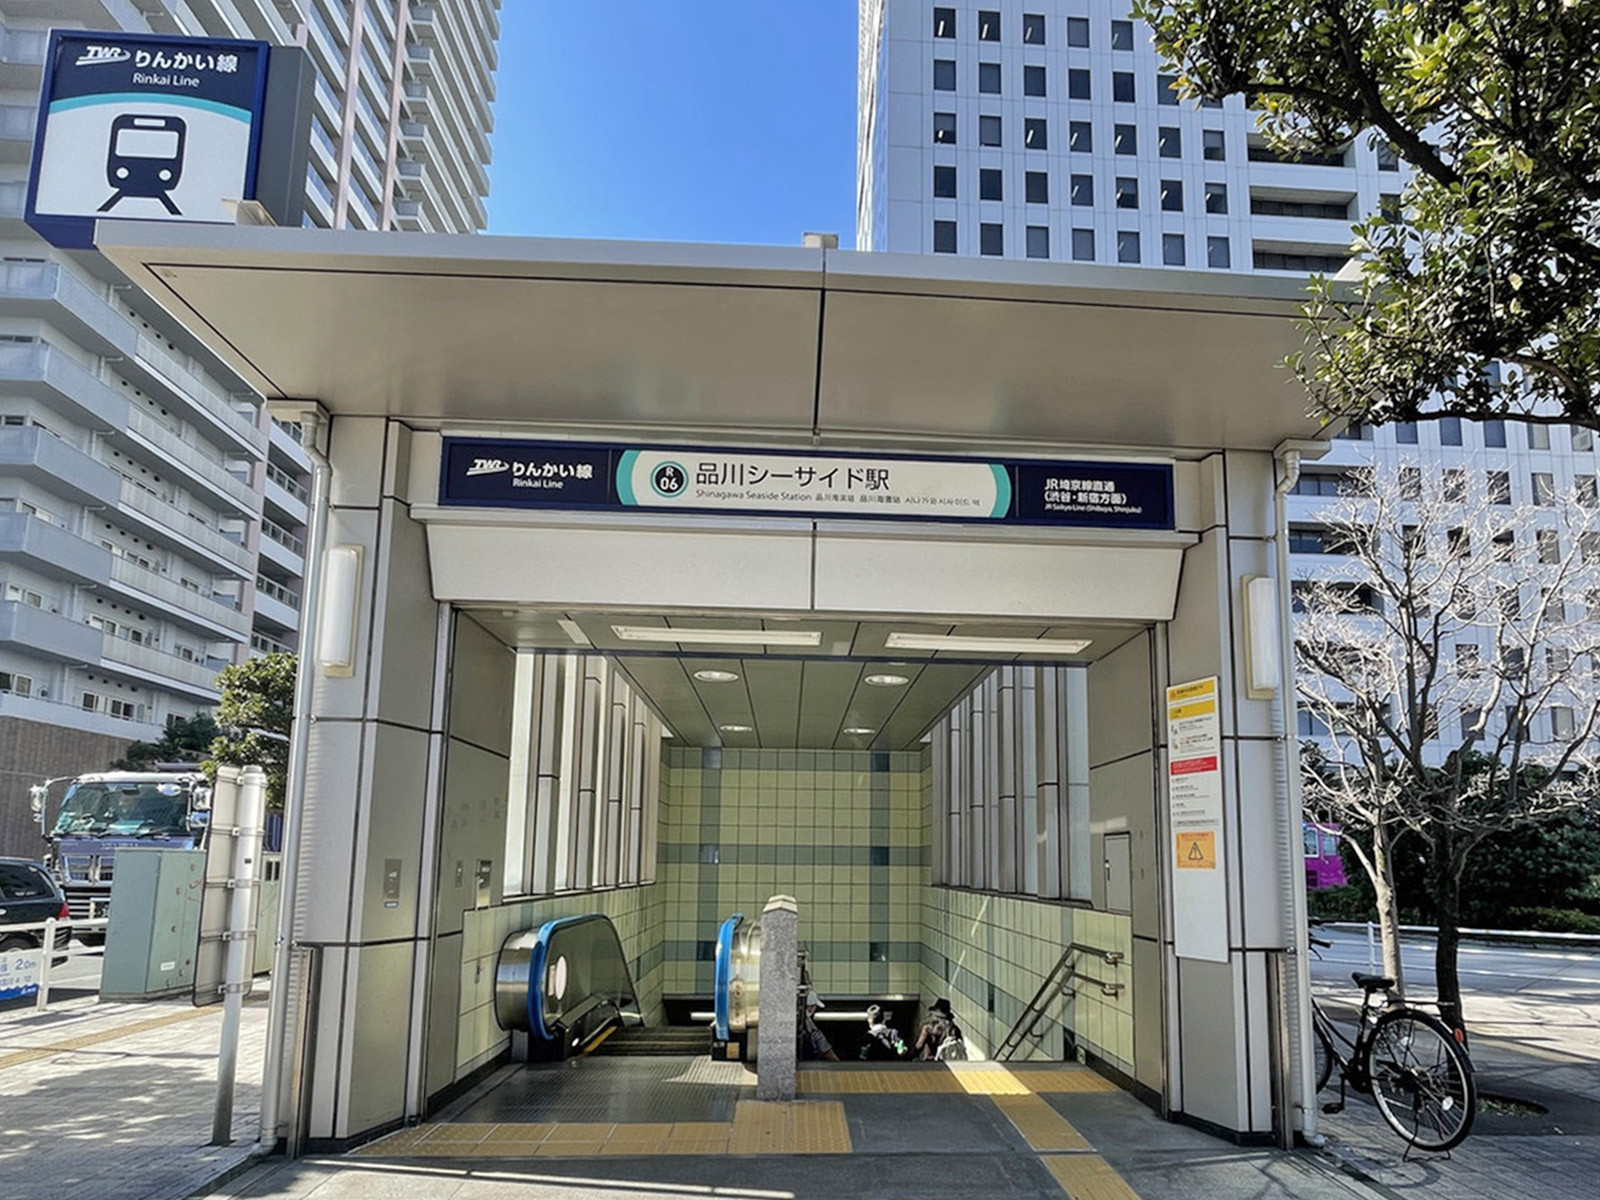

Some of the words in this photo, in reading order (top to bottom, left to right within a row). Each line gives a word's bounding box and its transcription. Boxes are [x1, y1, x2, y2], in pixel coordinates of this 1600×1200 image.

[79, 45, 127, 62] TWR
[135, 50, 238, 73] りんかい線
[132, 72, 171, 85] Rinkai
[173, 75, 200, 87] Line
[469, 459, 506, 473] TWR
[512, 461, 593, 479] りんかい線
[665, 466, 674, 477] R
[512, 478, 541, 488] Rinkai
[543, 479, 564, 489] Line
[660, 477, 679, 491] 06
[696, 462, 890, 491] 品川シーサイド駅
[1044, 478, 1115, 493] JR埼京線直通
[696, 489, 744, 500] Shinagawa
[746, 491, 779, 501] Seaside
[781, 492, 812, 502] Station
